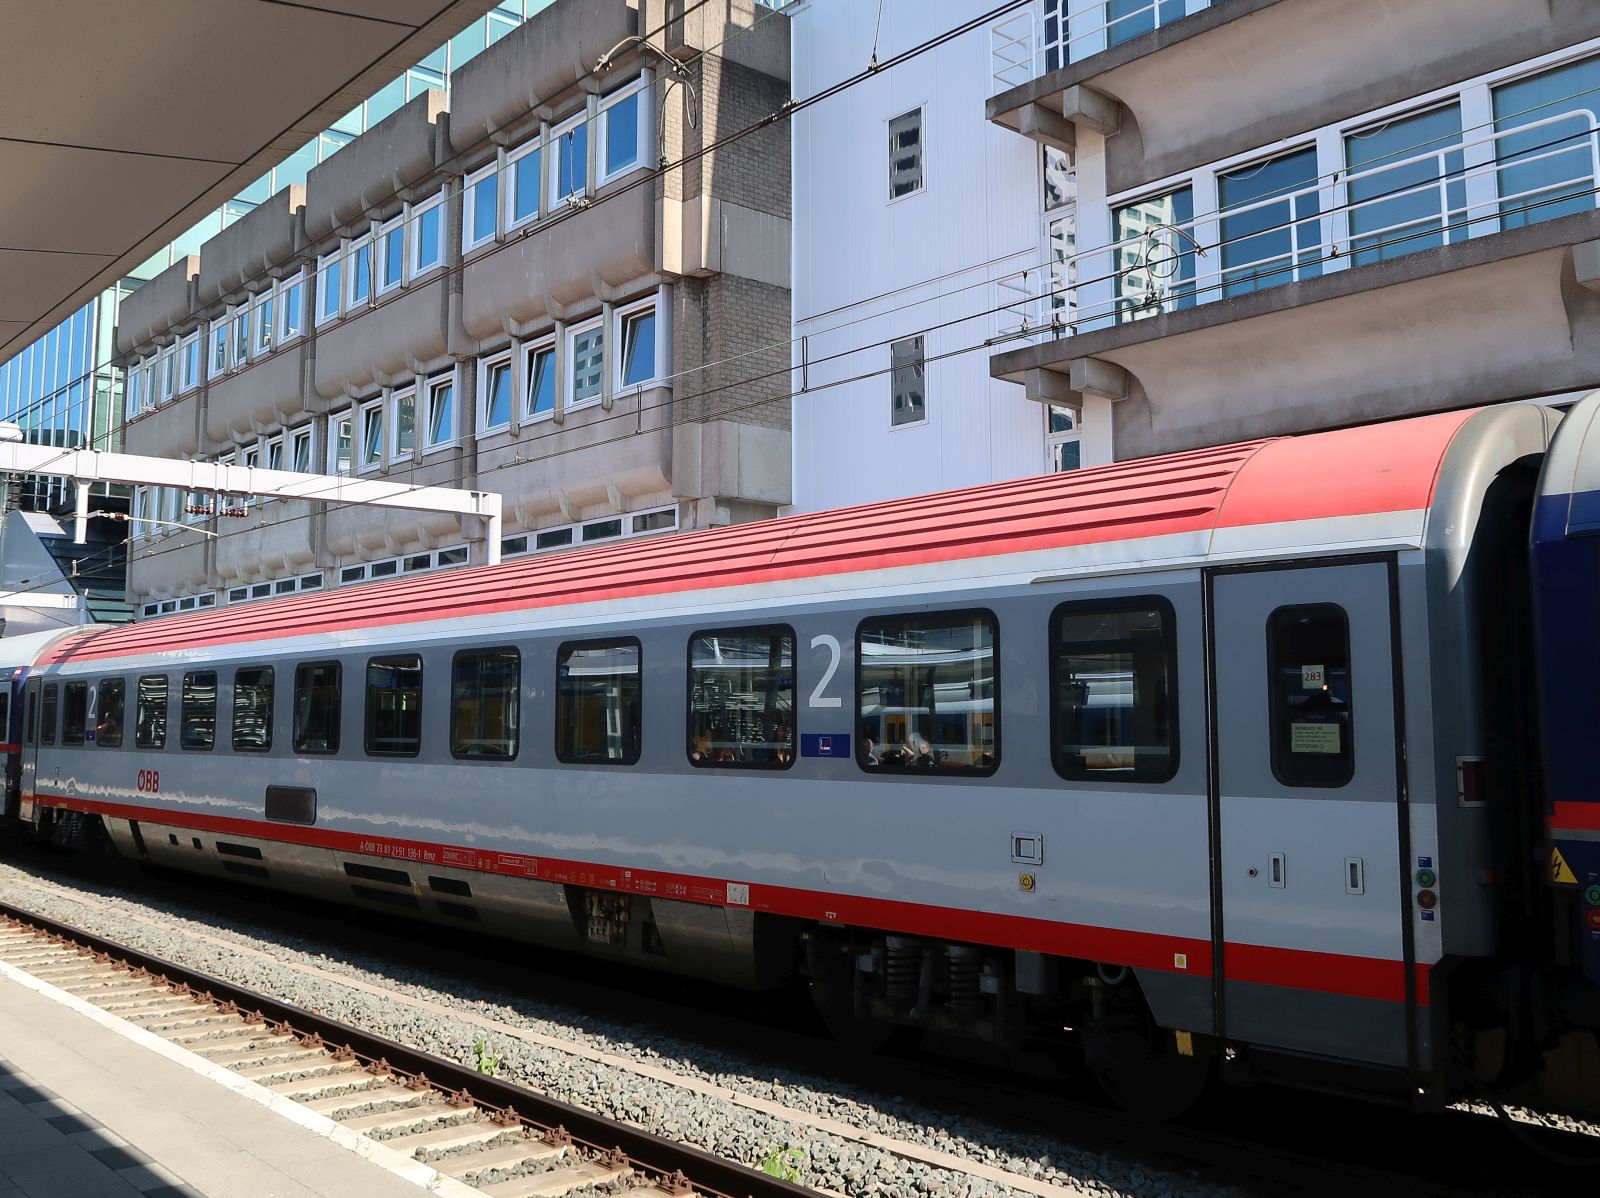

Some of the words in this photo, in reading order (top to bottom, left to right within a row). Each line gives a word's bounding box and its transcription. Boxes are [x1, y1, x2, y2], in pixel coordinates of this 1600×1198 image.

[809, 634, 841, 708] 2
[1304, 672, 1321, 681] 283
[88, 686, 97, 718] 2
[137, 769, 160, 793] ÖBB
[376, 843, 383, 853] 73
